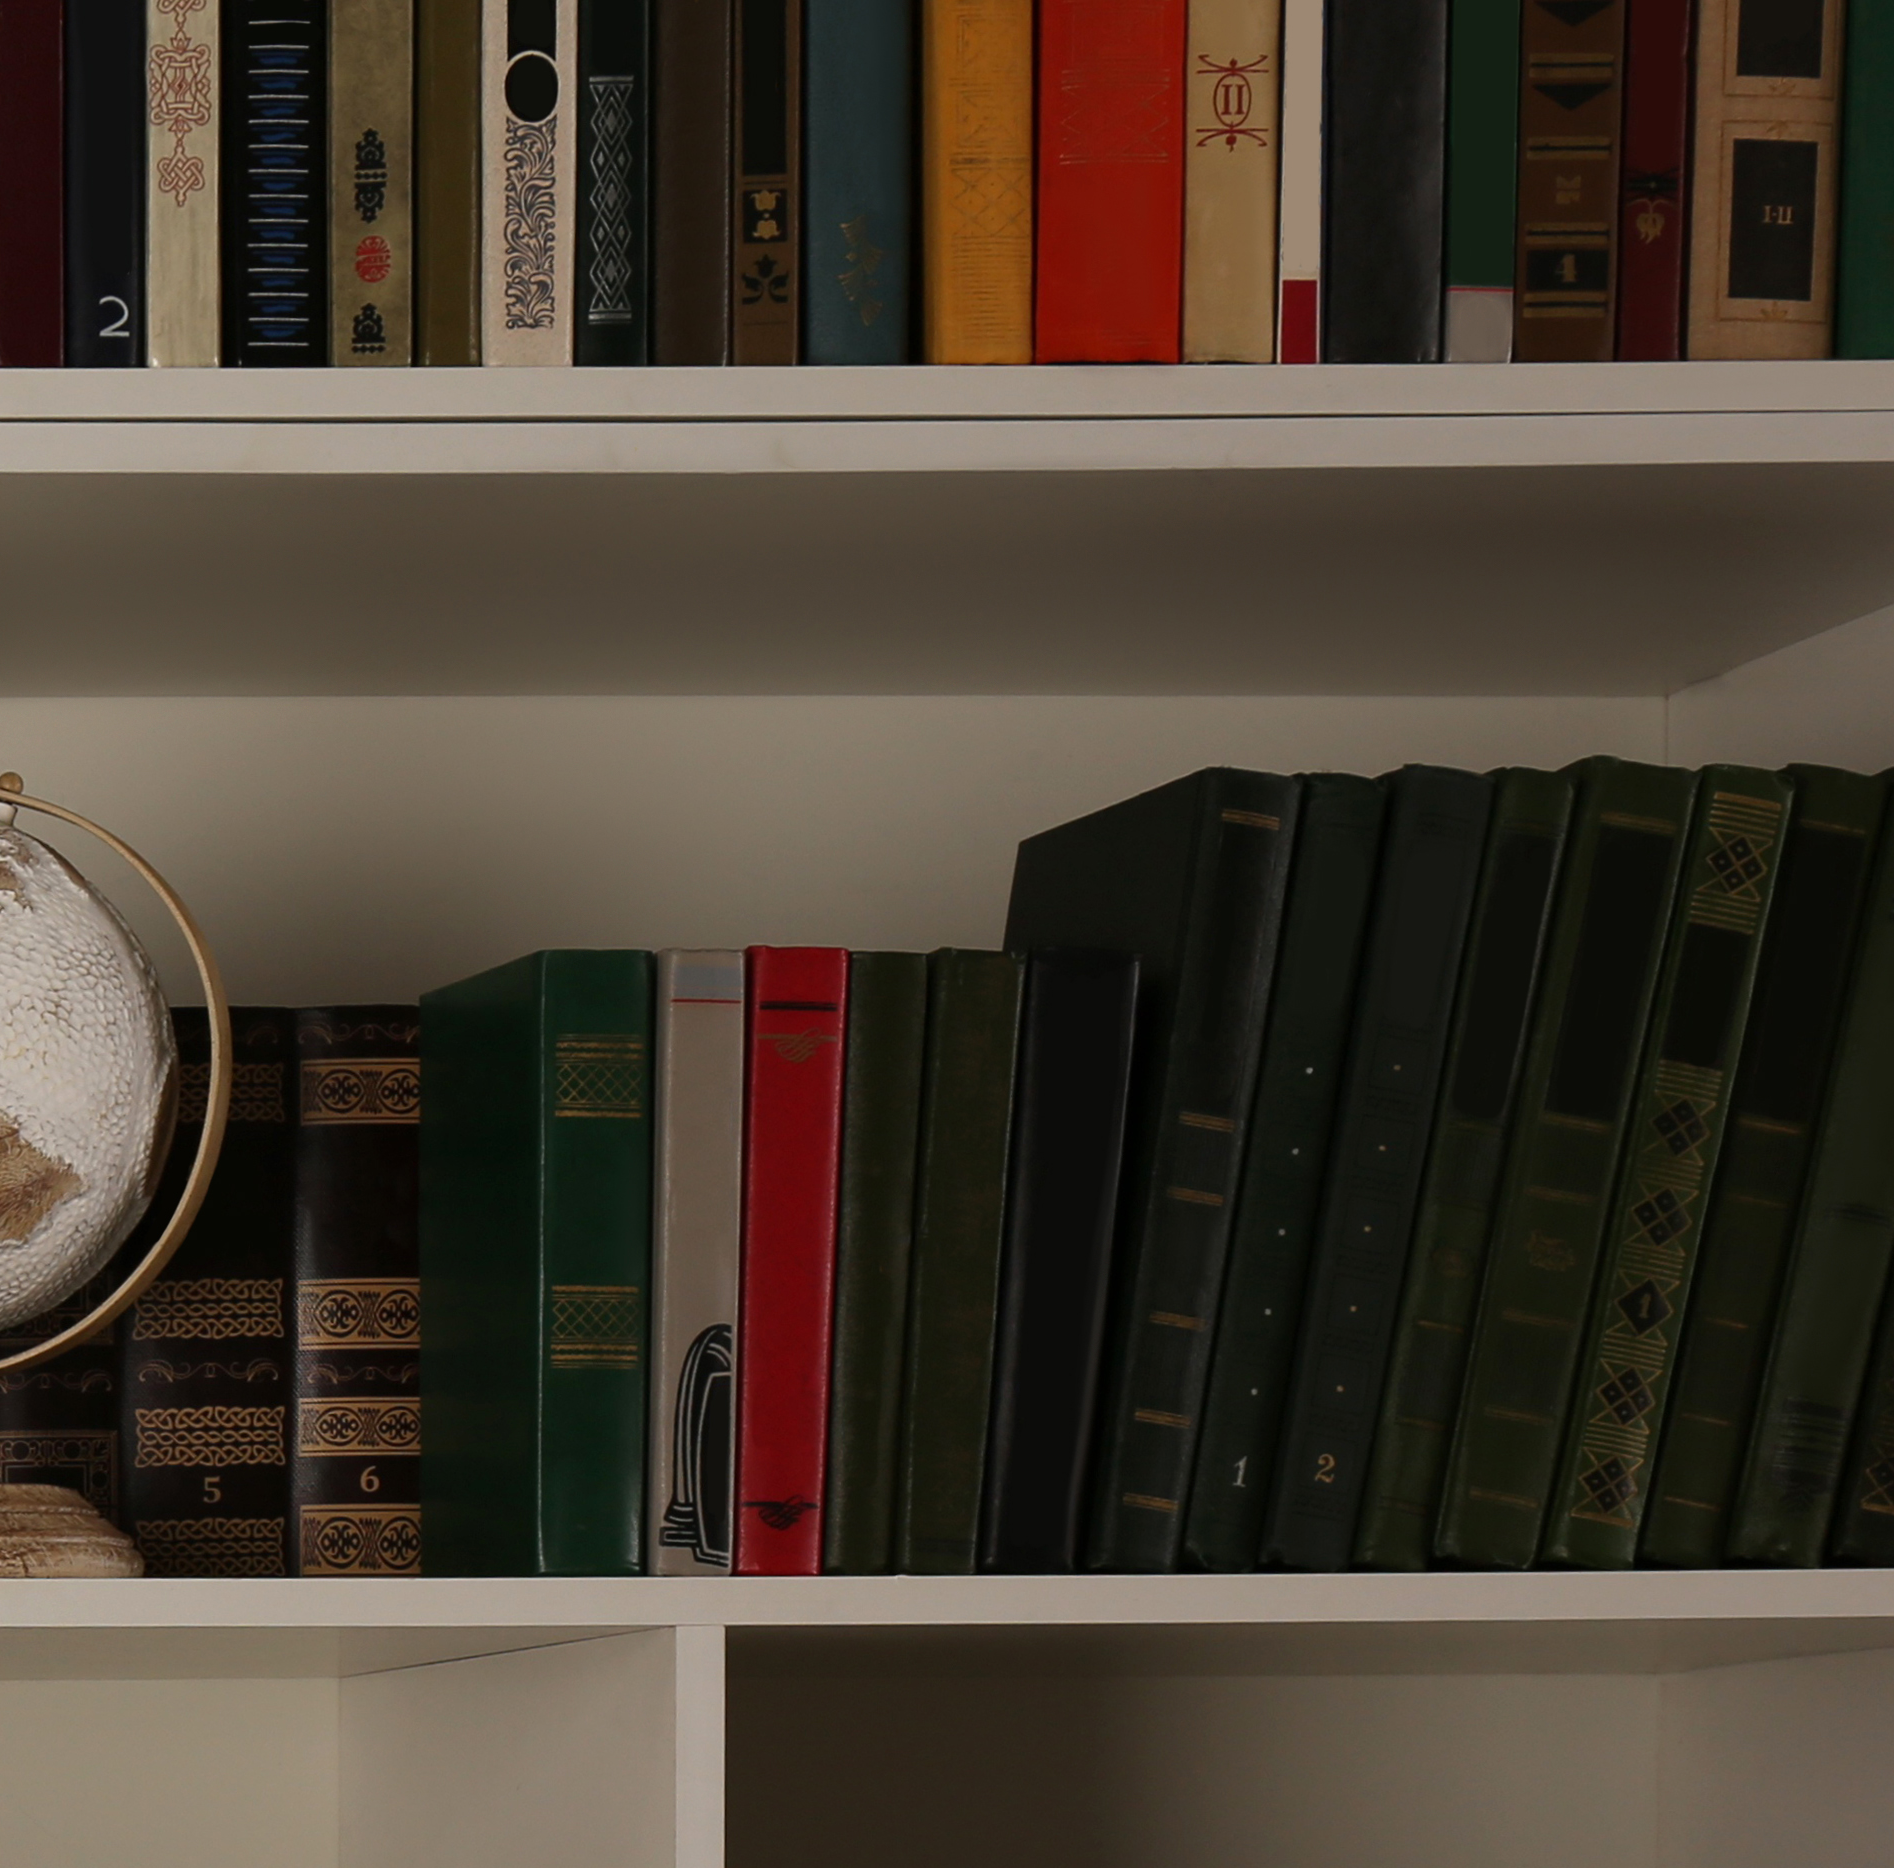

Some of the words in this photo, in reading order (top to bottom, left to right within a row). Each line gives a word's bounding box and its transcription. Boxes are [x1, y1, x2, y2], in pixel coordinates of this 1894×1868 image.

[1221, 84, 1246, 116] II
[1556, 253, 1577, 282] 4
[100, 296, 130, 337] 2
[1640, 1293, 1652, 1319] 1
[360, 1466, 380, 1492] 6
[1232, 1455, 1248, 1487] 1
[1314, 1453, 1335, 1484] 2
[203, 1476, 221, 1503] 5
